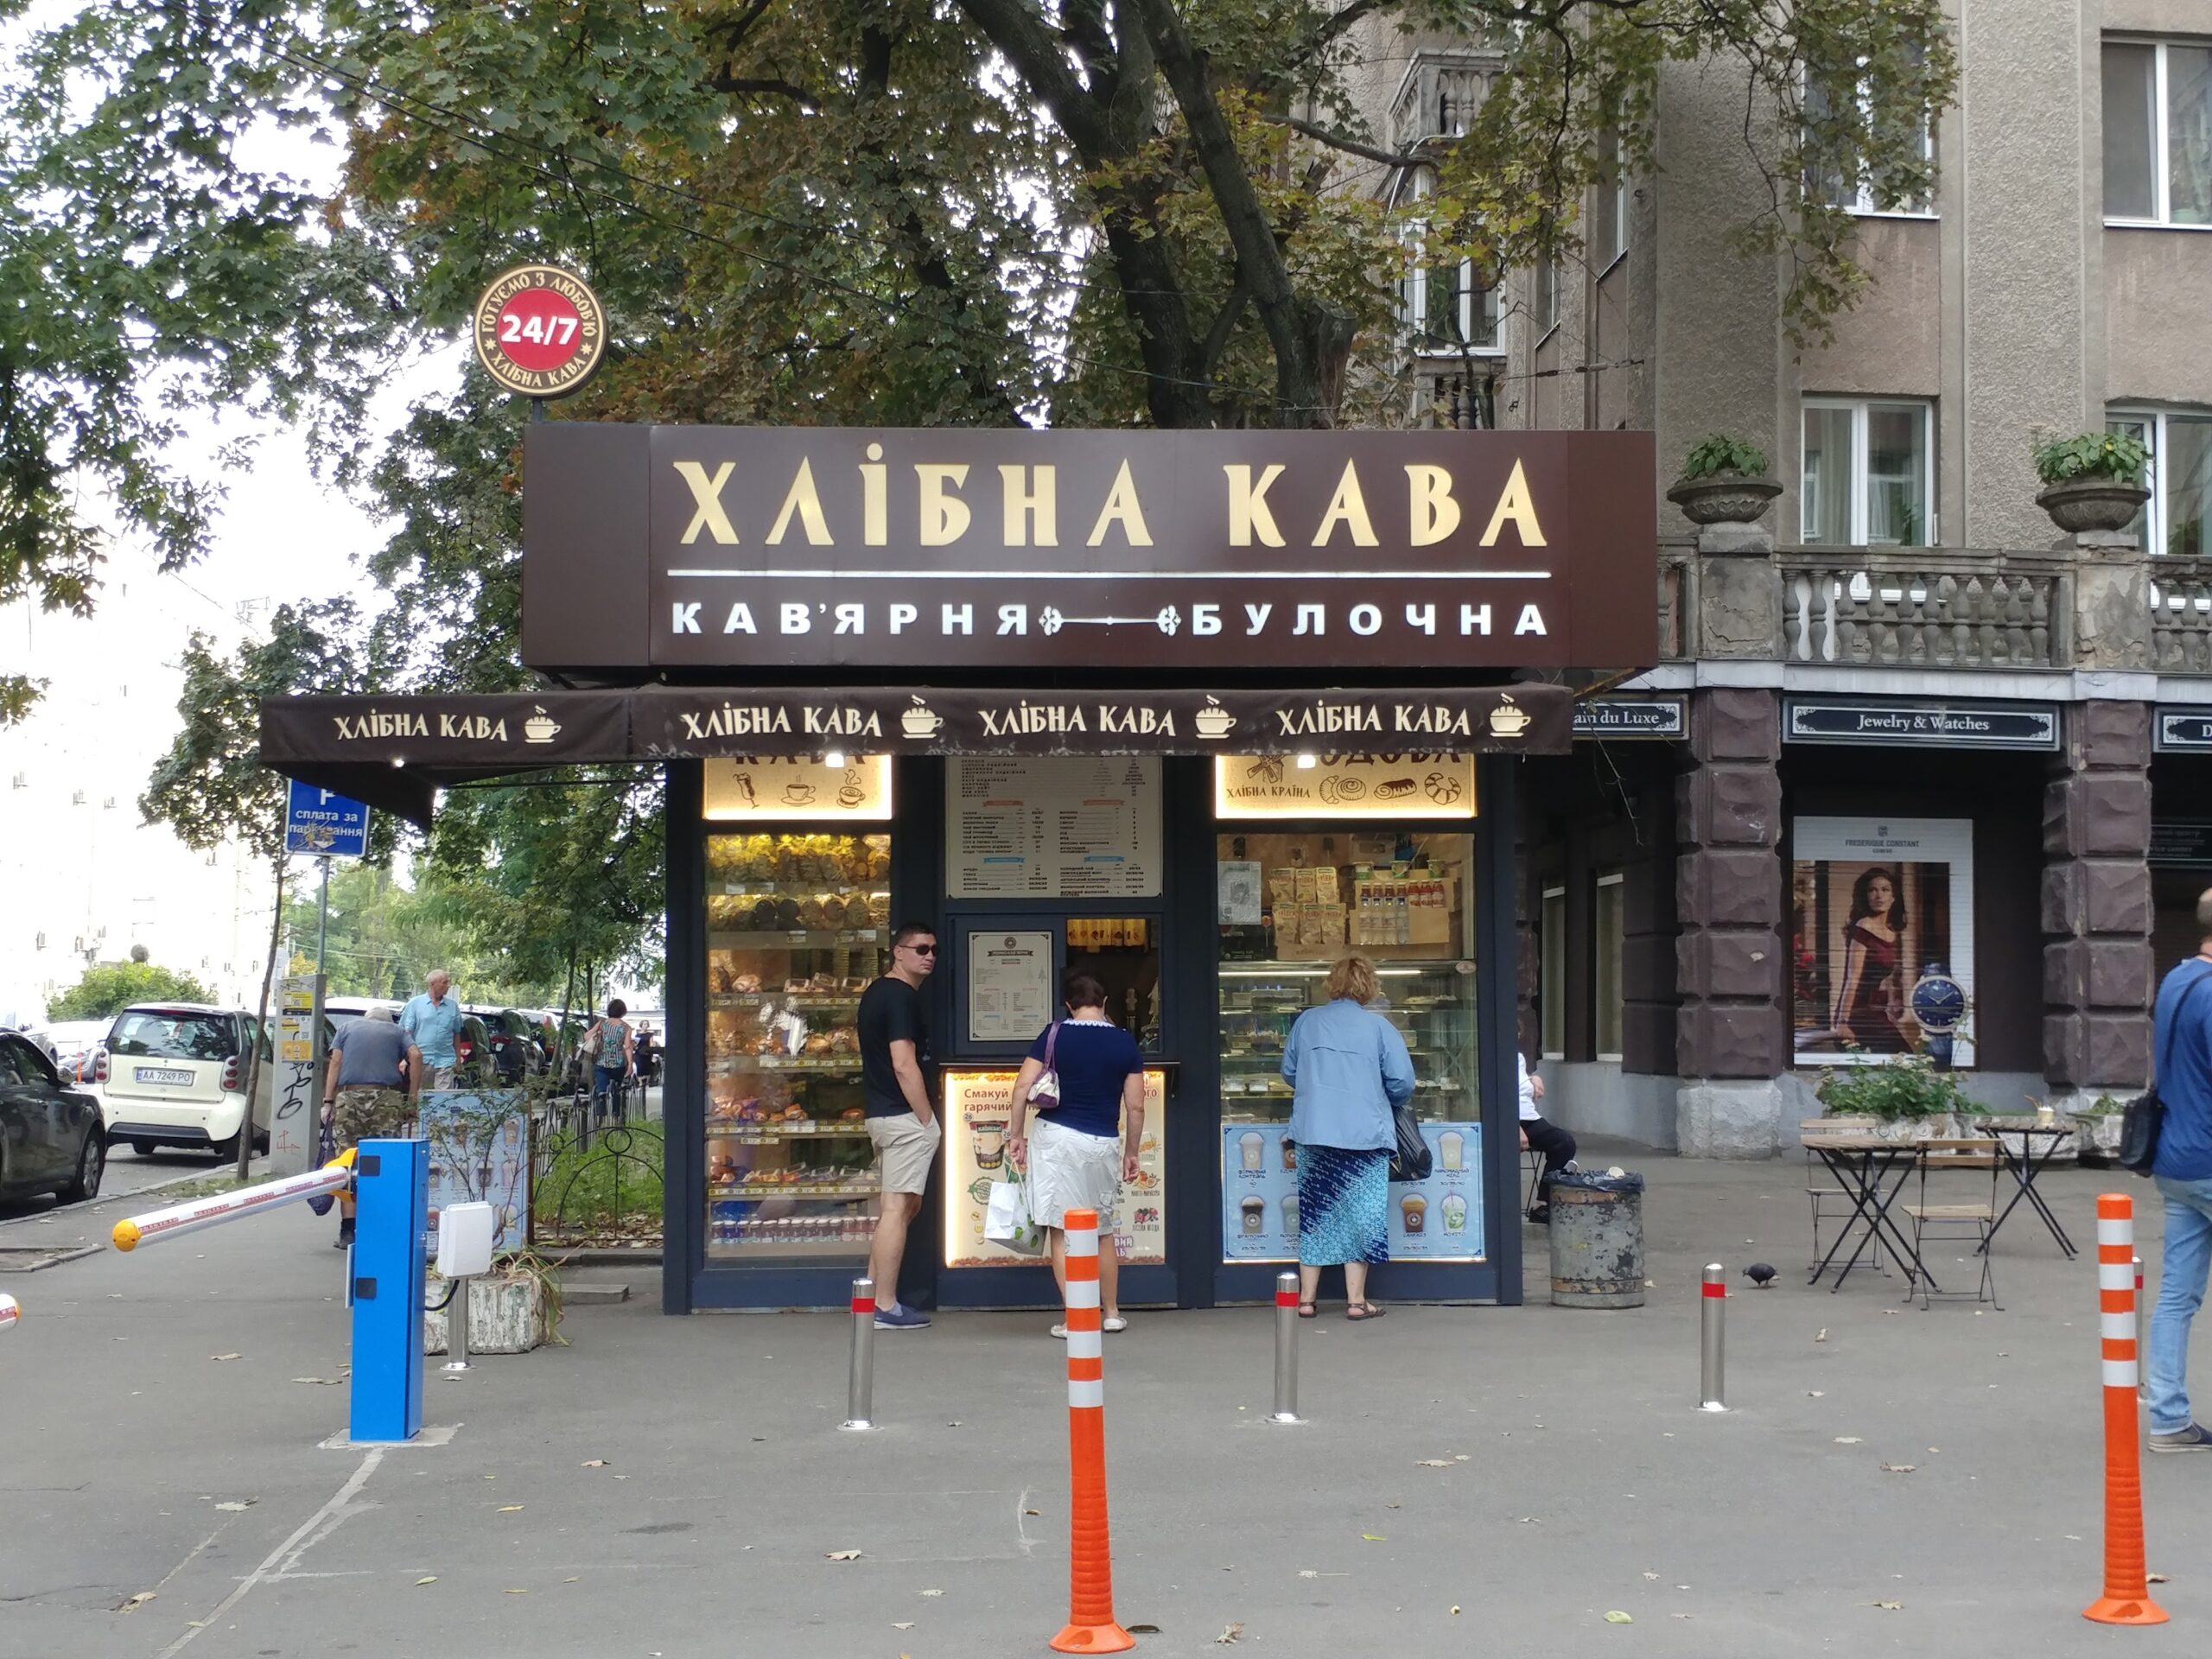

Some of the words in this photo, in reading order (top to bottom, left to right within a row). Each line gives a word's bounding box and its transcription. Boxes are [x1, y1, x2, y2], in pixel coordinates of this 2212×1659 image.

[481, 272, 531, 334] ГОТУЄМО
[535, 272, 545, 287] З
[549, 276, 599, 337] ЛЮБОВ'Ю
[500, 315, 578, 346] 24/7
[491, 352, 543, 388] ХЛІБНА
[548, 355, 587, 386] КАВА
[672, 442, 1154, 547] ХЛІБНА
[1222, 457, 1548, 548] КАВА
[671, 602, 1027, 635] КАВ'ЯРНЯ
[1192, 603, 1548, 636] БУЛОЧНА
[333, 708, 429, 741] ХЛІБНА
[439, 713, 509, 742] КАВА
[681, 701, 792, 741] ХЛІБНА
[803, 705, 882, 739] КАВА
[978, 699, 1088, 737] ХЛІБНА
[1098, 704, 1177, 736] КАВА
[1275, 698, 1382, 736] ХЛІБНА
[1394, 704, 1471, 735] КАВА
[1599, 709, 1619, 724] du
[1623, 711, 1660, 724] Luxe
[1856, 714, 1911, 734] Jewelry
[1913, 715, 1927, 729] &
[1929, 715, 1990, 732] Watches
[1226, 784, 1268, 798] ХЛІБНА
[1270, 785, 1311, 798] КРАЇНА
[296, 810, 340, 821] сплата
[343, 812, 359, 823] за
[963, 1088, 1009, 1100] Смакуй
[963, 1102, 1013, 1114] гарячий
